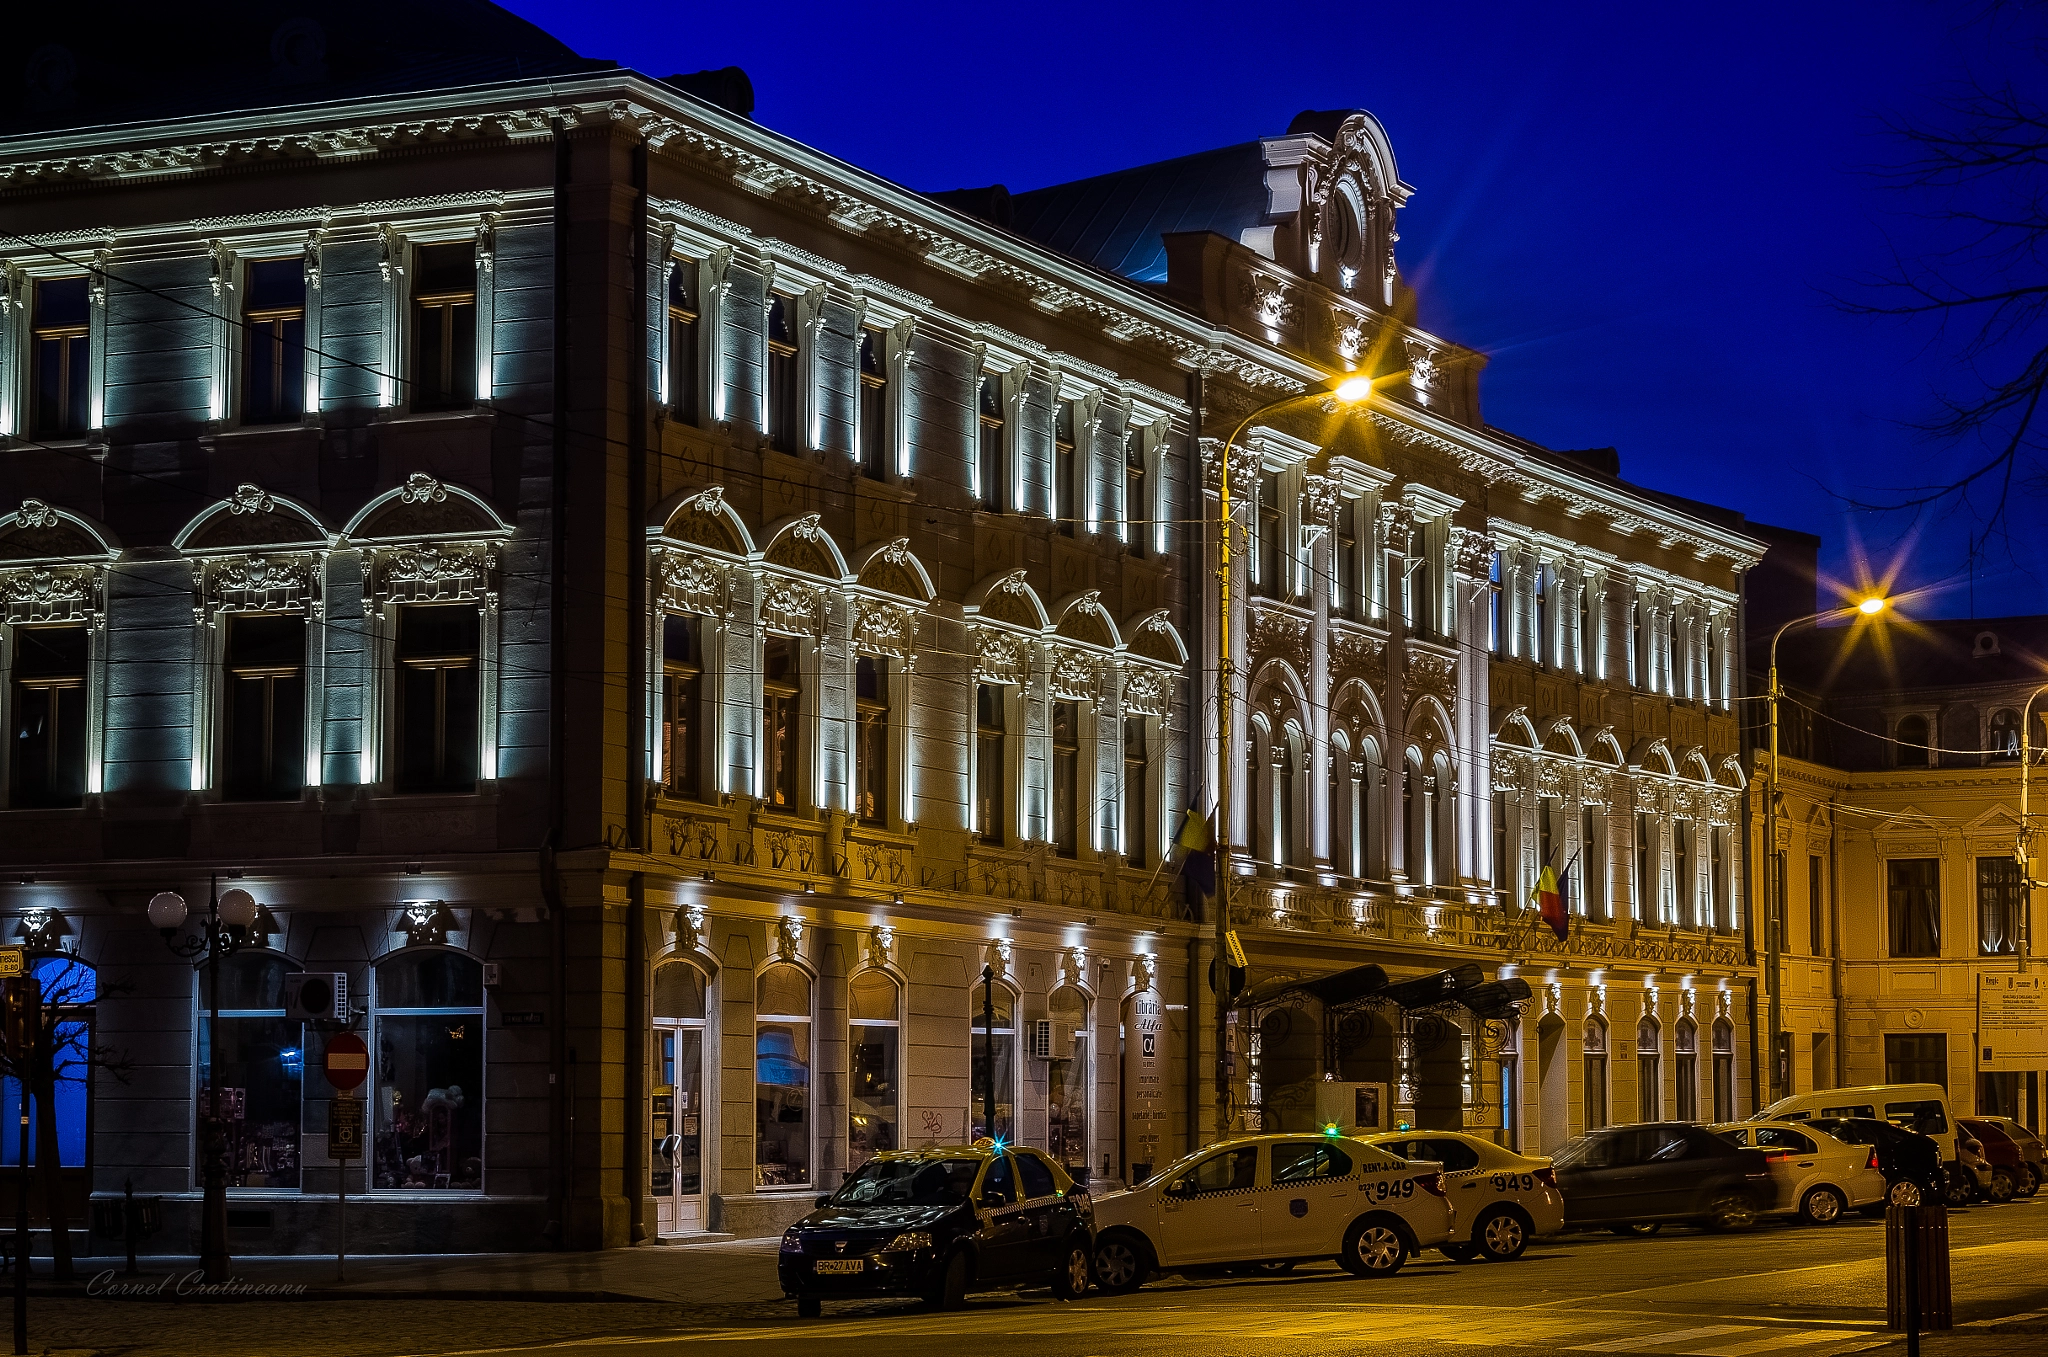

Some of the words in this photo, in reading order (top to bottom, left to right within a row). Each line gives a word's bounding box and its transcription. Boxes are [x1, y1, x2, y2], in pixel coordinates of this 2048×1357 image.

[1134, 1018, 1163, 1032] Alfa
[1362, 1162, 1407, 1173] RENT-A-CAR
[1376, 1178, 1414, 1200] 949
[1494, 1174, 1533, 1192] 949
[818, 1261, 830, 1271] BR
[833, 1261, 843, 1271] 27
[845, 1261, 862, 1270] AVA
